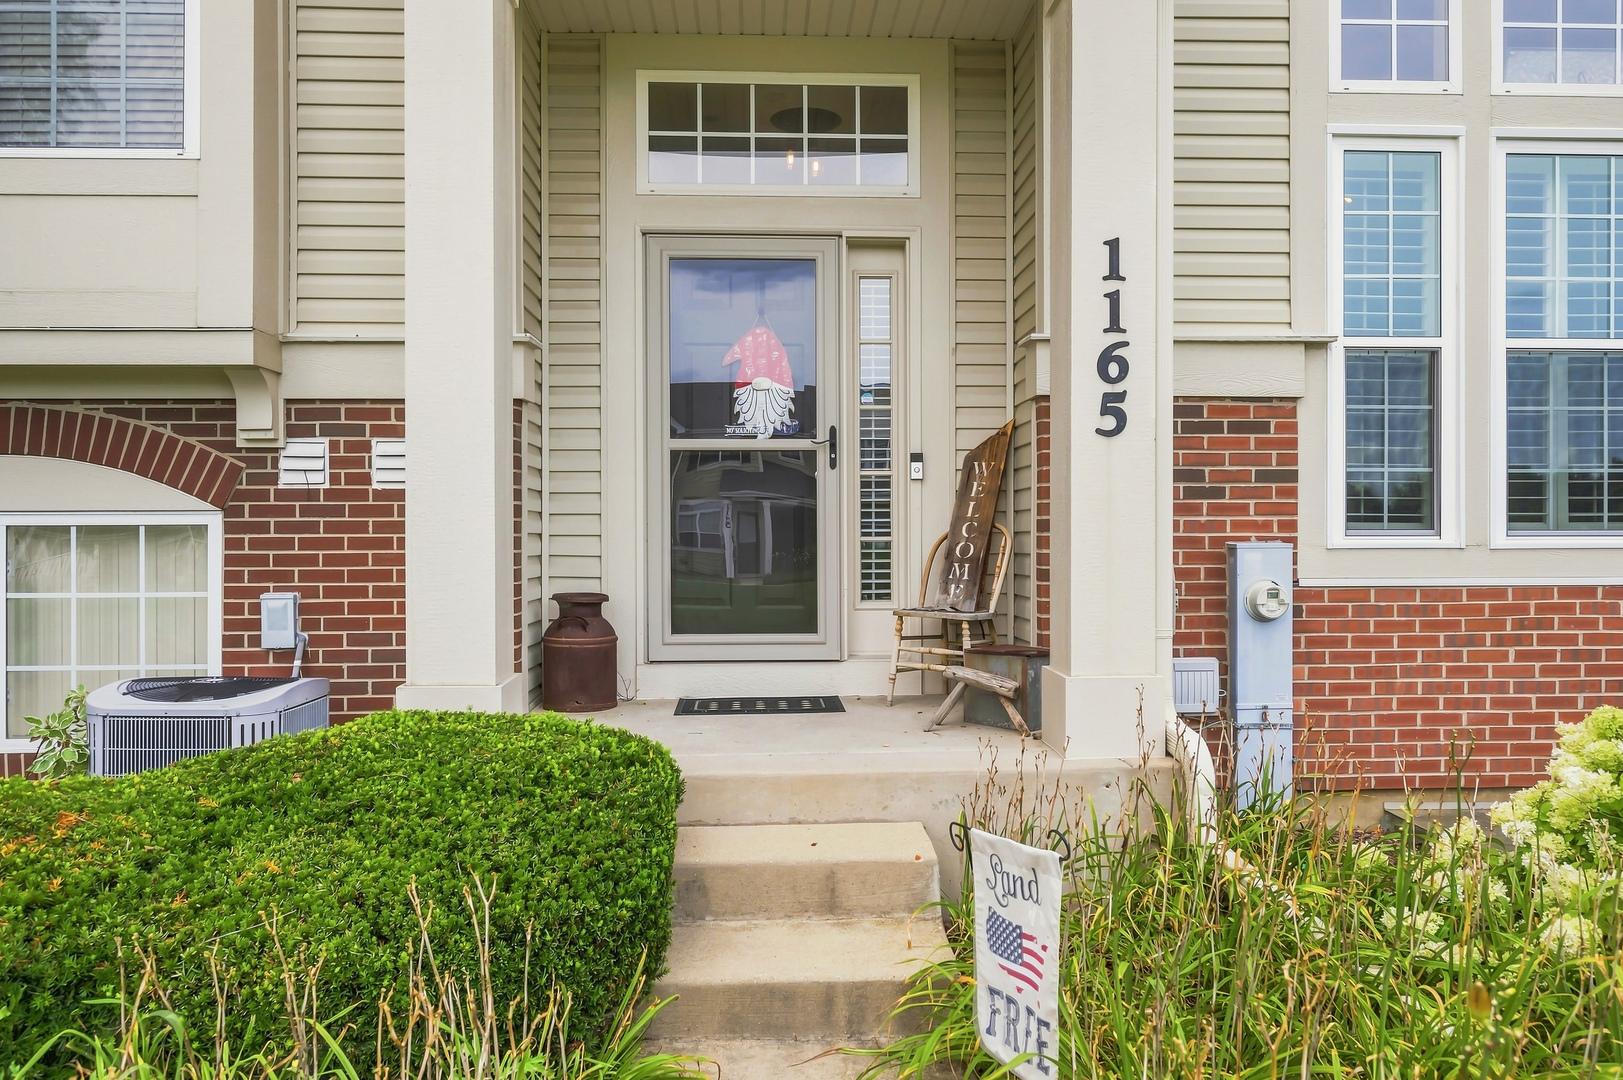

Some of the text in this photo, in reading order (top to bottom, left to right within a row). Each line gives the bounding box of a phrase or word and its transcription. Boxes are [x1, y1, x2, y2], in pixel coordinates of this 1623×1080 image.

[1095, 236, 1131, 438] 1165
[948, 461, 996, 600] WELCOME
[986, 853, 1042, 908] Land
[985, 984, 1051, 1077] FREE
